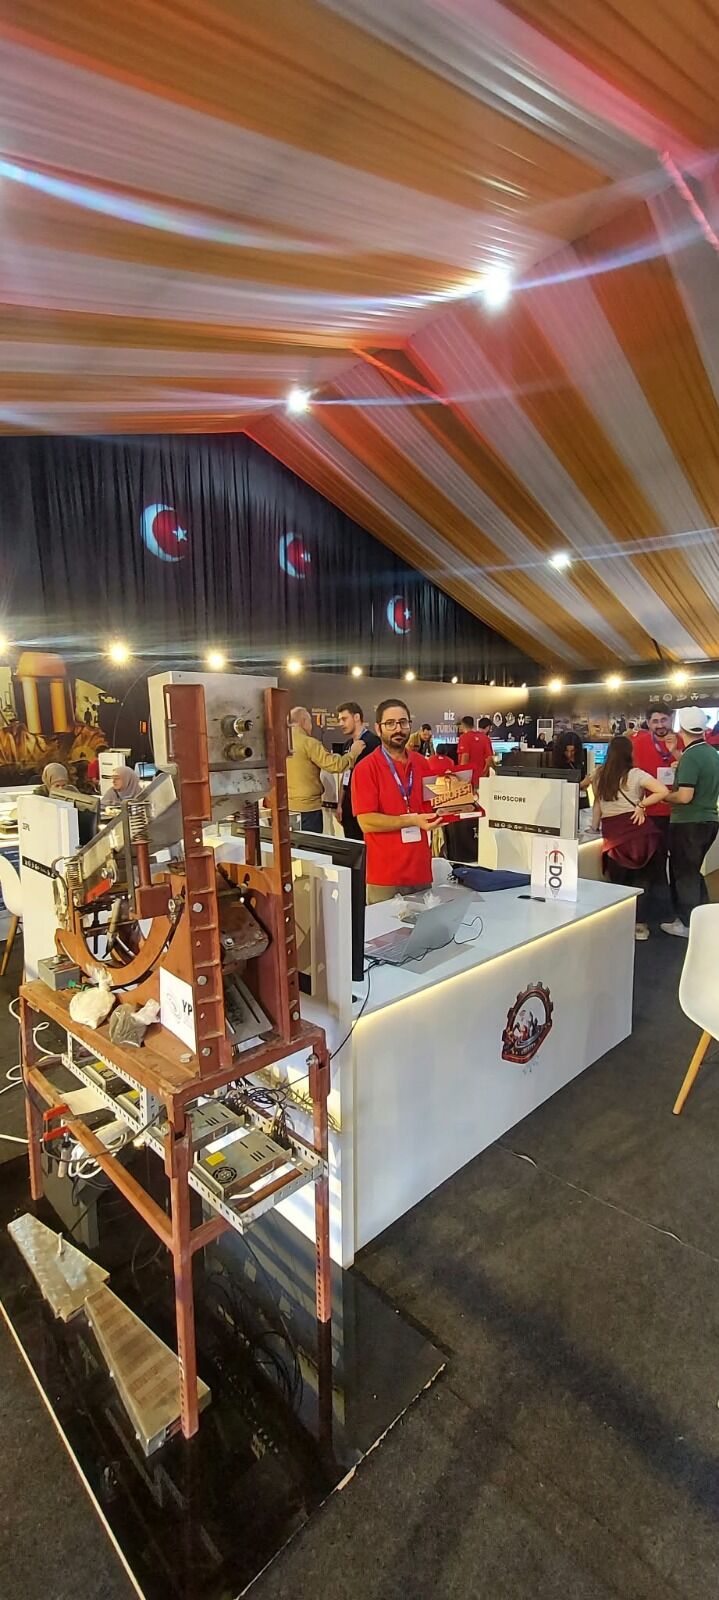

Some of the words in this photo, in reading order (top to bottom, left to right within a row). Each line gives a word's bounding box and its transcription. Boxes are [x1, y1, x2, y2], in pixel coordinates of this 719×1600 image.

[436, 722, 459, 734] TÜRKİY
[431, 783, 472, 808] TEKNOFEST
[493, 794, 526, 803] BHOSCORE
